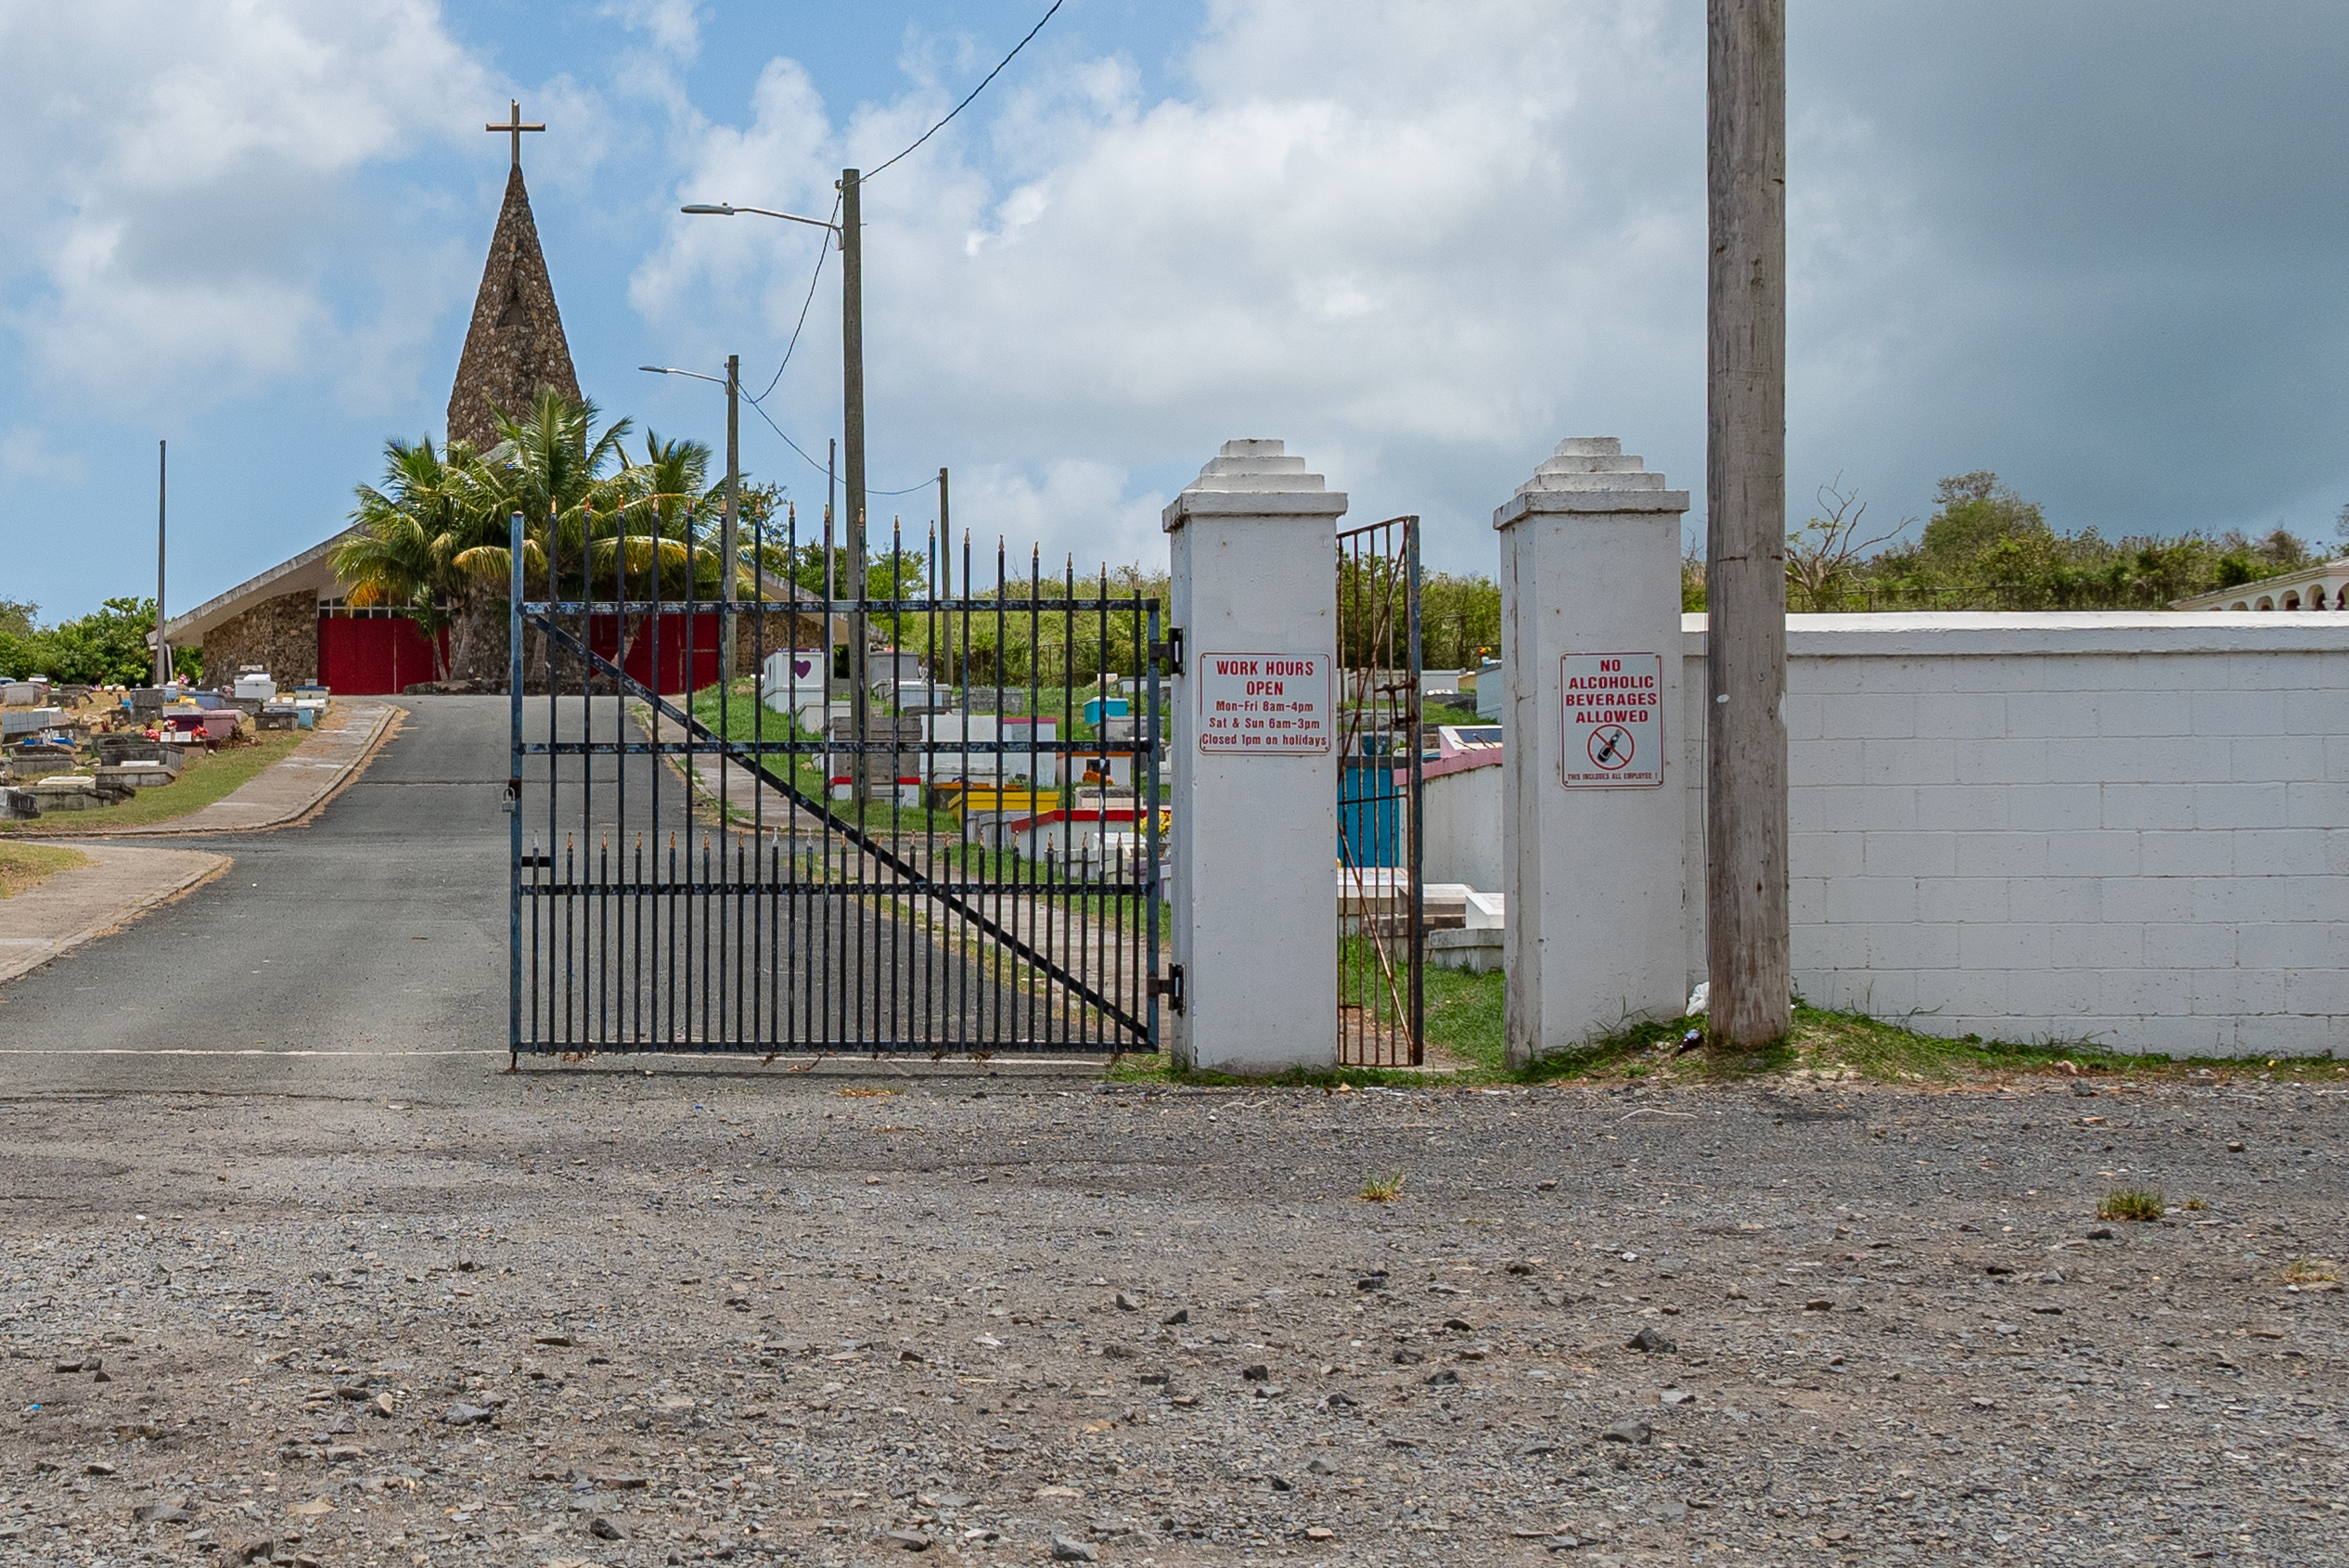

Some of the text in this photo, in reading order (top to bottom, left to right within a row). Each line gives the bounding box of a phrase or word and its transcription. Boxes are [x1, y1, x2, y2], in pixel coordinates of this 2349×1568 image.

[1216, 661, 1314, 676] WORK HOURS
[1600, 659, 1621, 672] NO
[1246, 681, 1284, 695] OPEN
[1569, 675, 1654, 689] ALCOHOLIC
[1566, 693, 1657, 706] BEVERAGES
[1216, 700, 1313, 713] Mon-Fri 8am-4pm
[1576, 710, 1648, 723] ALLOWED
[1209, 717, 1320, 730] Sat & Sun 6am-3pm
[1202, 733, 1327, 747] Closed 1pm on holidays
